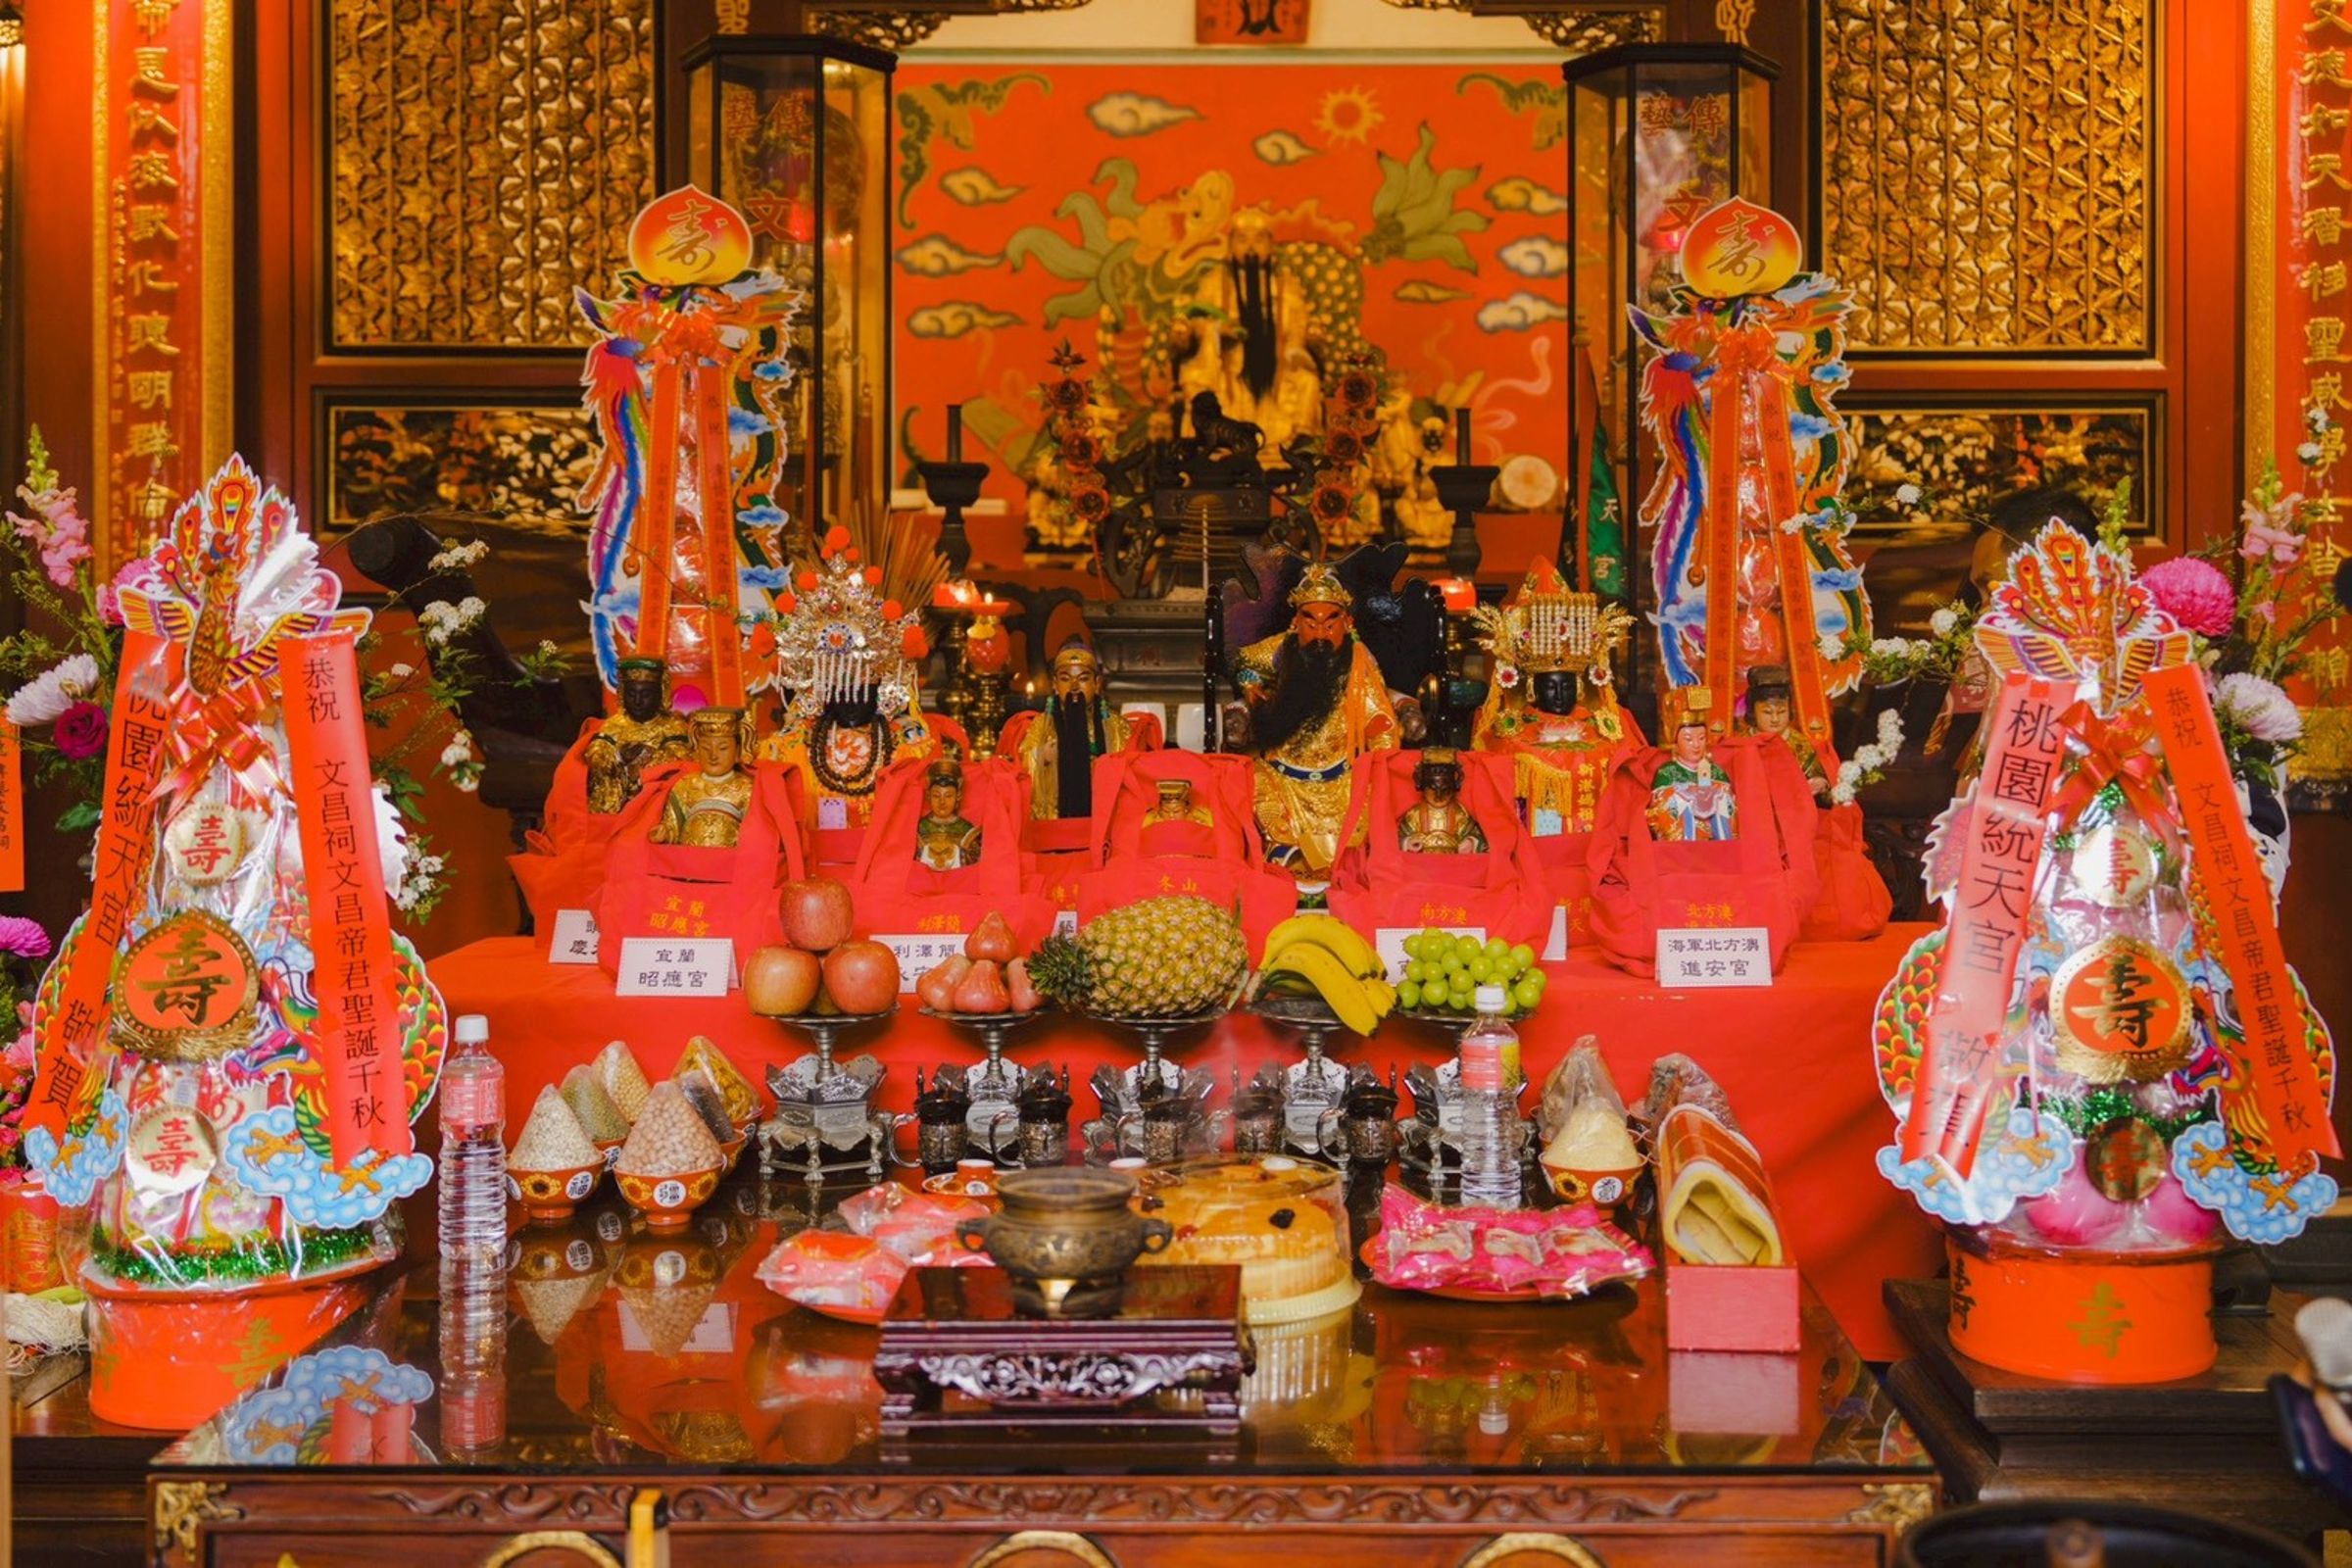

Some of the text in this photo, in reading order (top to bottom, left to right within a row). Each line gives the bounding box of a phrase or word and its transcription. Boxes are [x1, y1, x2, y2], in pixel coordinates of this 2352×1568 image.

[180, 813, 232, 875] 壽
[1964, 699, 2058, 976] 桃園統天宮
[301, 658, 386, 1130] 恭祝 文昌祠文昌帝君聖誕千秋
[1159, 874, 1197, 893] 冬山
[2166, 687, 2312, 1135] 恭祝 文昌祠文昌帝君聖誕千秋
[136, 923, 232, 1026] 壽
[638, 970, 708, 988] 昭應宮
[654, 948, 696, 963] 宜蘭
[2070, 954, 2171, 1050] 壽
[143, 1117, 199, 1178] 壽
